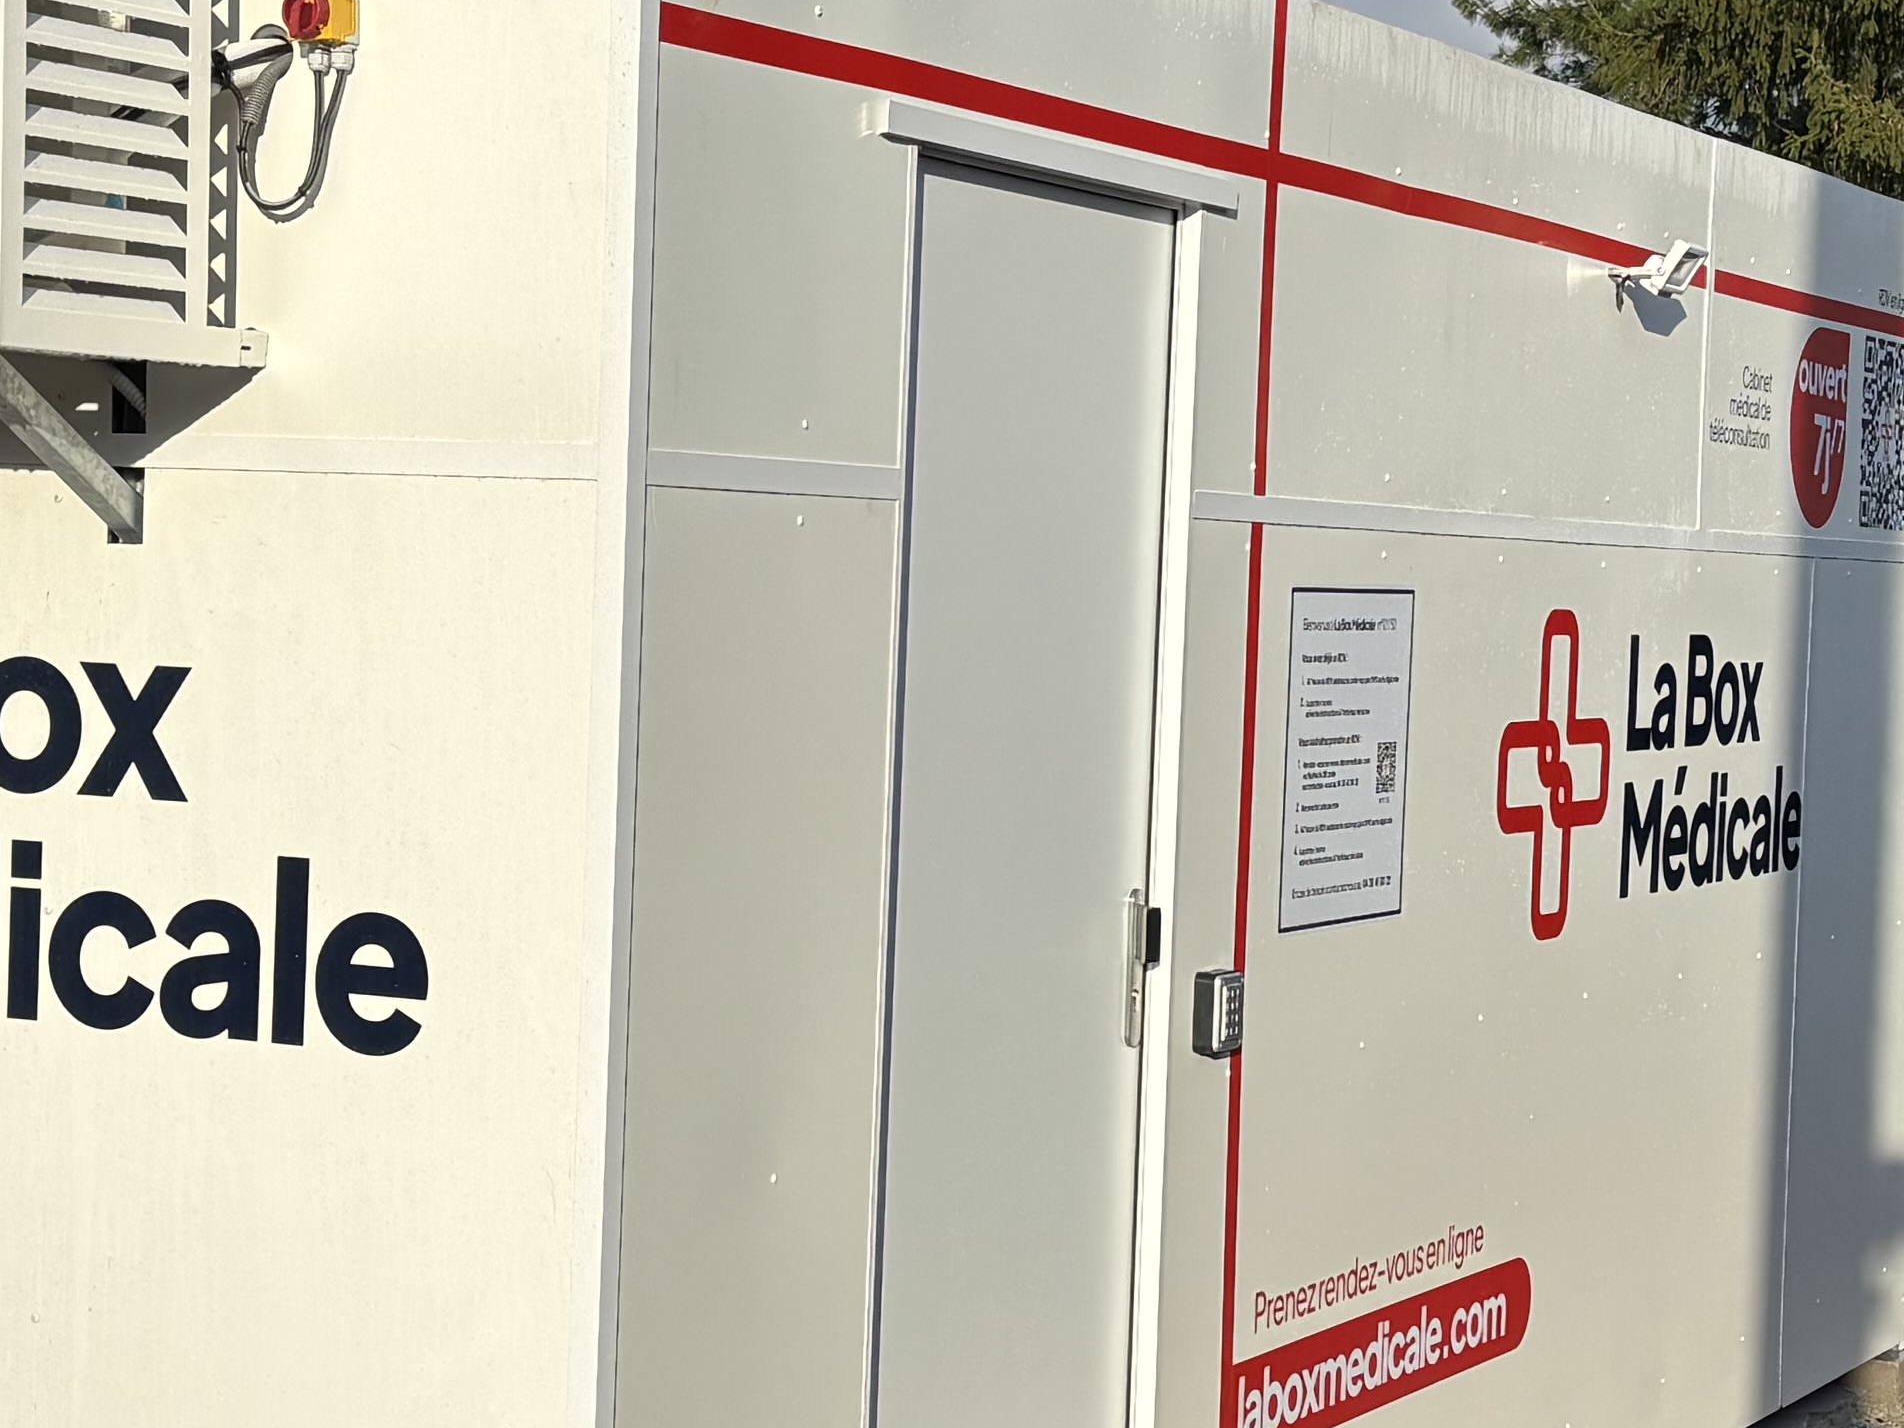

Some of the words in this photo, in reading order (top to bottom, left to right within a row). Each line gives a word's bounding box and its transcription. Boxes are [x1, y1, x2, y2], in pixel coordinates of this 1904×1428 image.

[1729, 392, 1760, 419] médical
[1761, 398, 1772, 422] de
[1742, 365, 1772, 393] Cabinet
[1799, 358, 1847, 404] ouvert
[1709, 417, 1771, 450] téléconsultation
[1813, 412, 1845, 495] 7j/7
[1626, 634, 1677, 752] La
[1684, 634, 1764, 747] Box
[1619, 765, 1803, 899] Médicale
[1253, 1289, 1316, 1334] Prenez
[1317, 1244, 1425, 1309] rendez-vous
[1425, 1238, 1447, 1267] en
[1447, 1224, 1485, 1270] ligne
